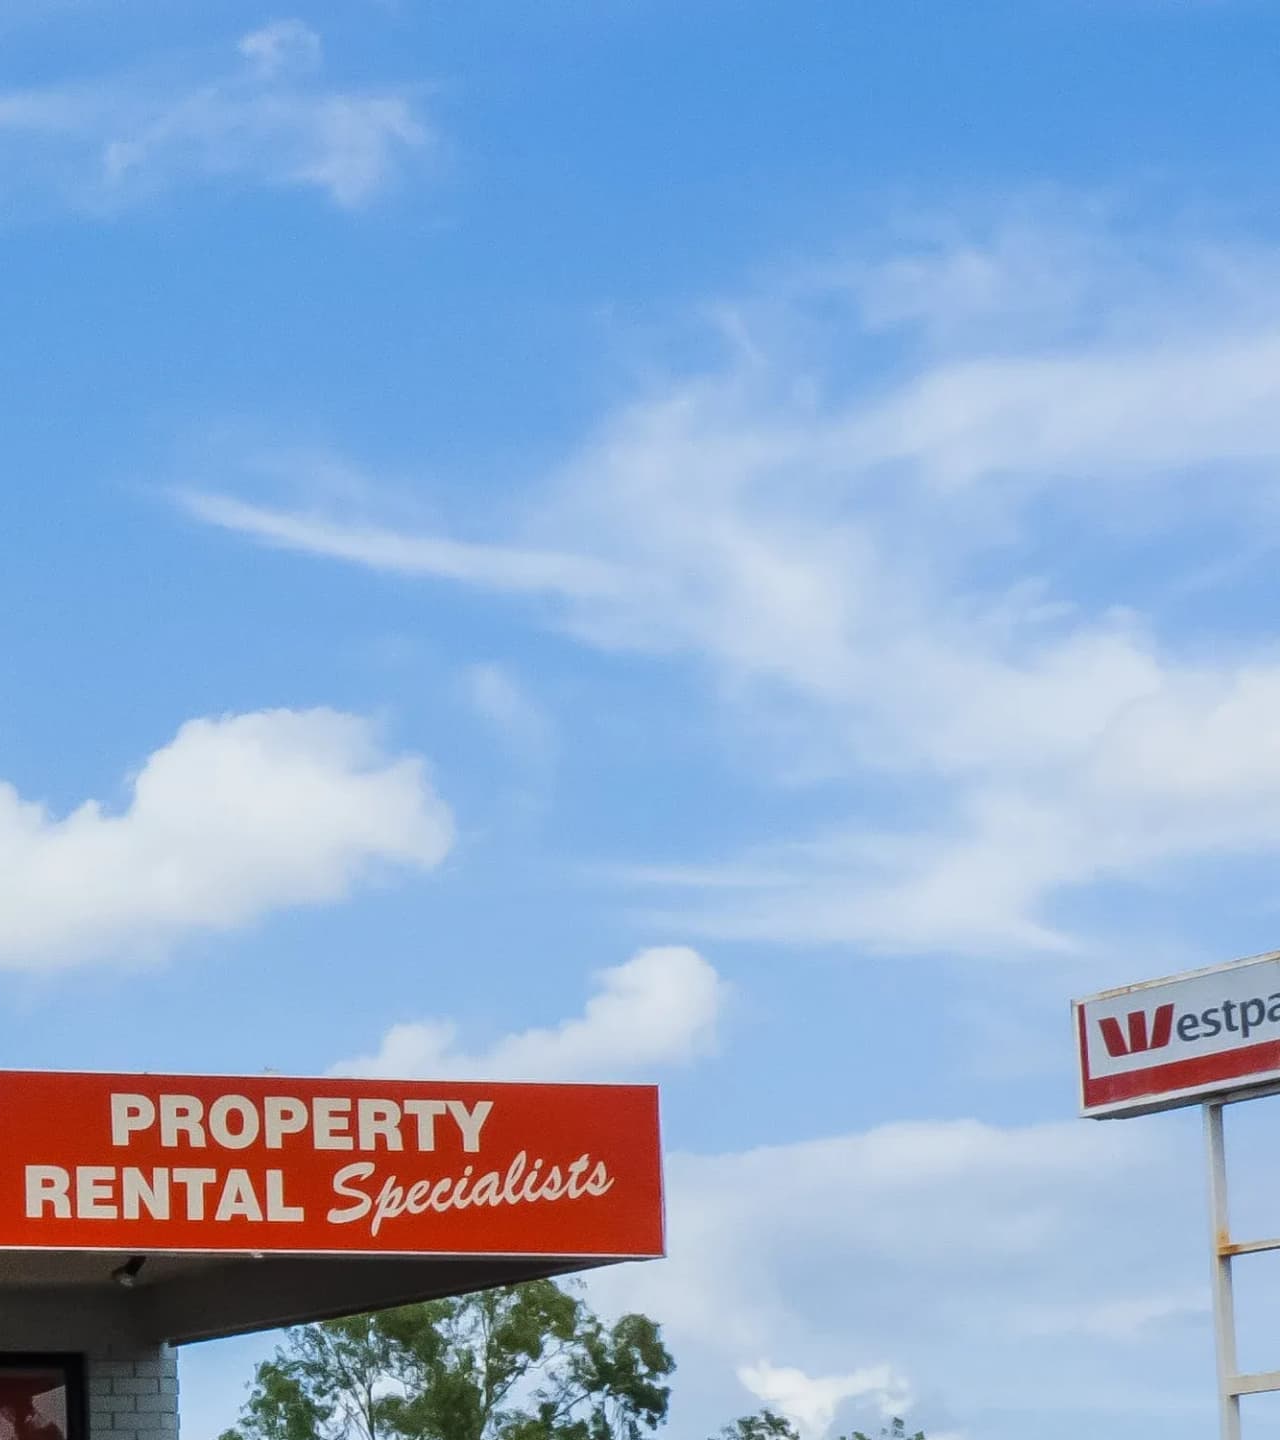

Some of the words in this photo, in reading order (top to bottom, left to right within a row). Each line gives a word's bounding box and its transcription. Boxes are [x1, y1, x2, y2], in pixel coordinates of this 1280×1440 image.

[110, 1093, 493, 1152] PROPERTY
[25, 1165, 304, 1222] RENTAL
[327, 1150, 614, 1237] Specialists
